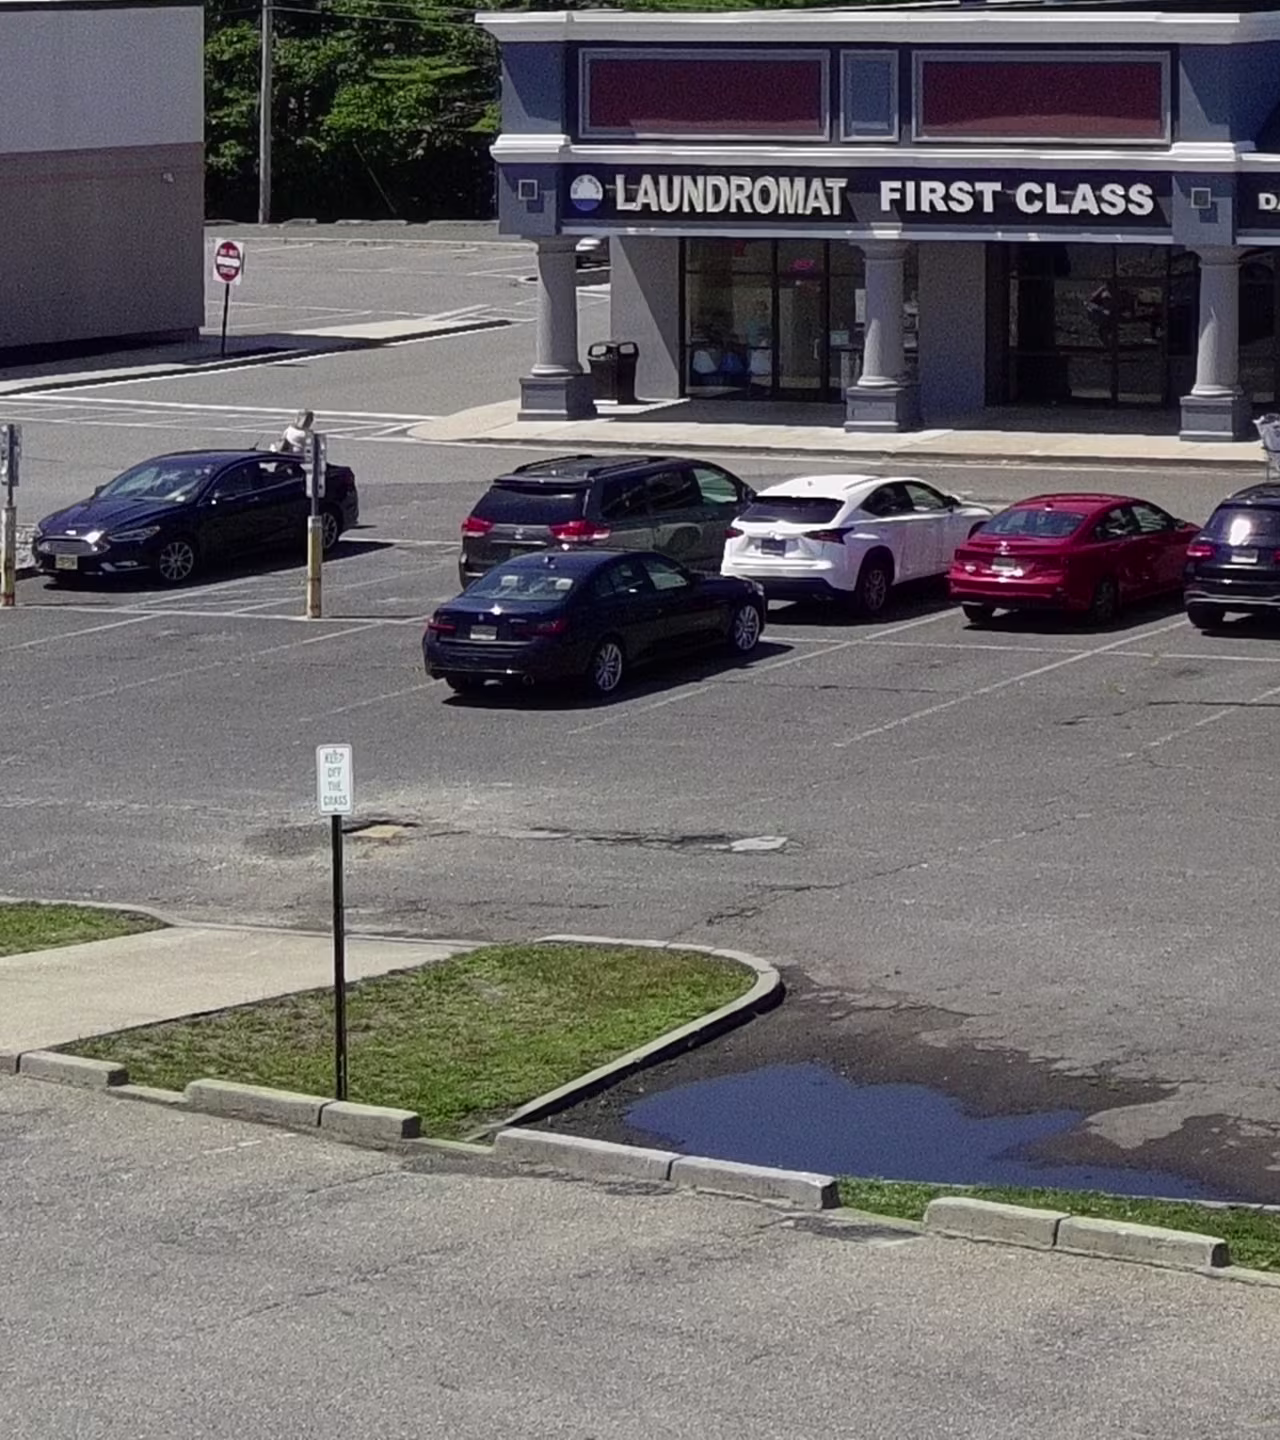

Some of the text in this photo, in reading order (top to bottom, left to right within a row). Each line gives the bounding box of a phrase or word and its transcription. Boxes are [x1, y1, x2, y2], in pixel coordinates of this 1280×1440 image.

[615, 174, 848, 215] LAUNDROMAT
[879, 180, 1154, 215] FIRST CLASS
